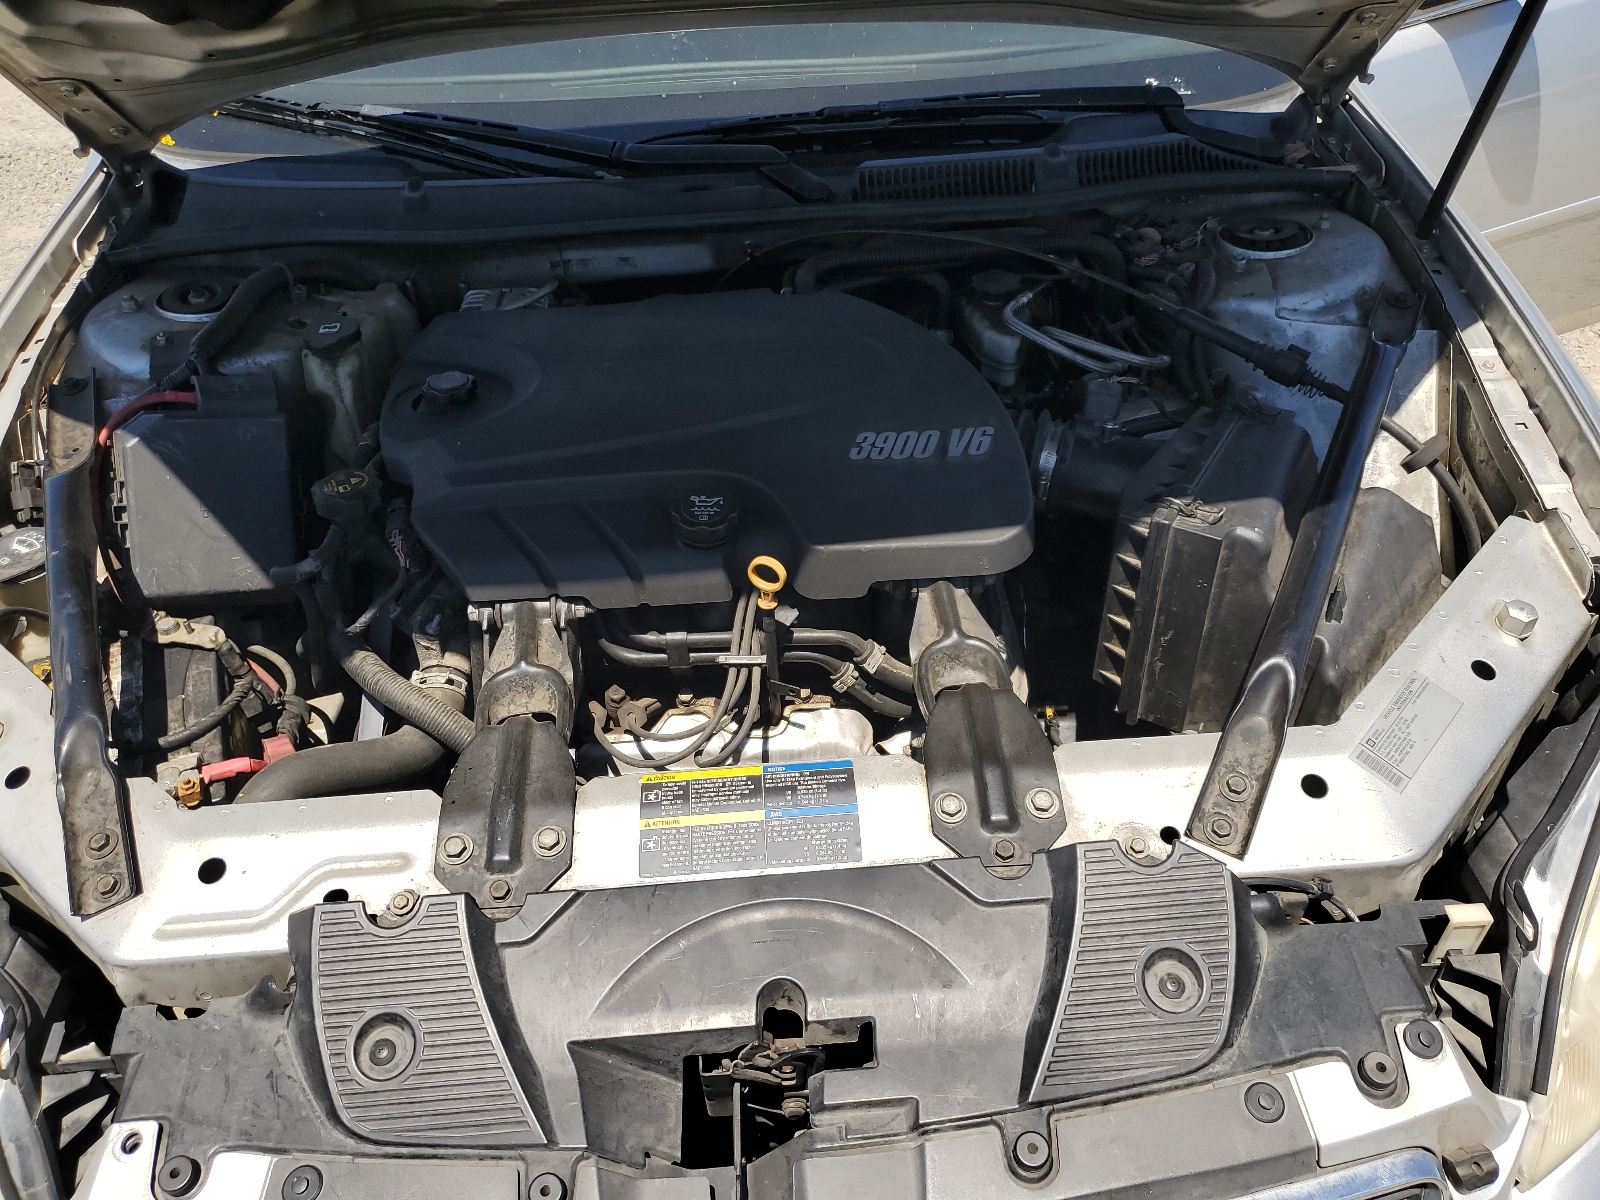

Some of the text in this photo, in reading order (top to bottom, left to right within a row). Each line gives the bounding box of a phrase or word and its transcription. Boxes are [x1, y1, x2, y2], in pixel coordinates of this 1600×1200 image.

[849, 426, 995, 460] 3900 V6
[652, 819, 680, 827] ATTENTION
